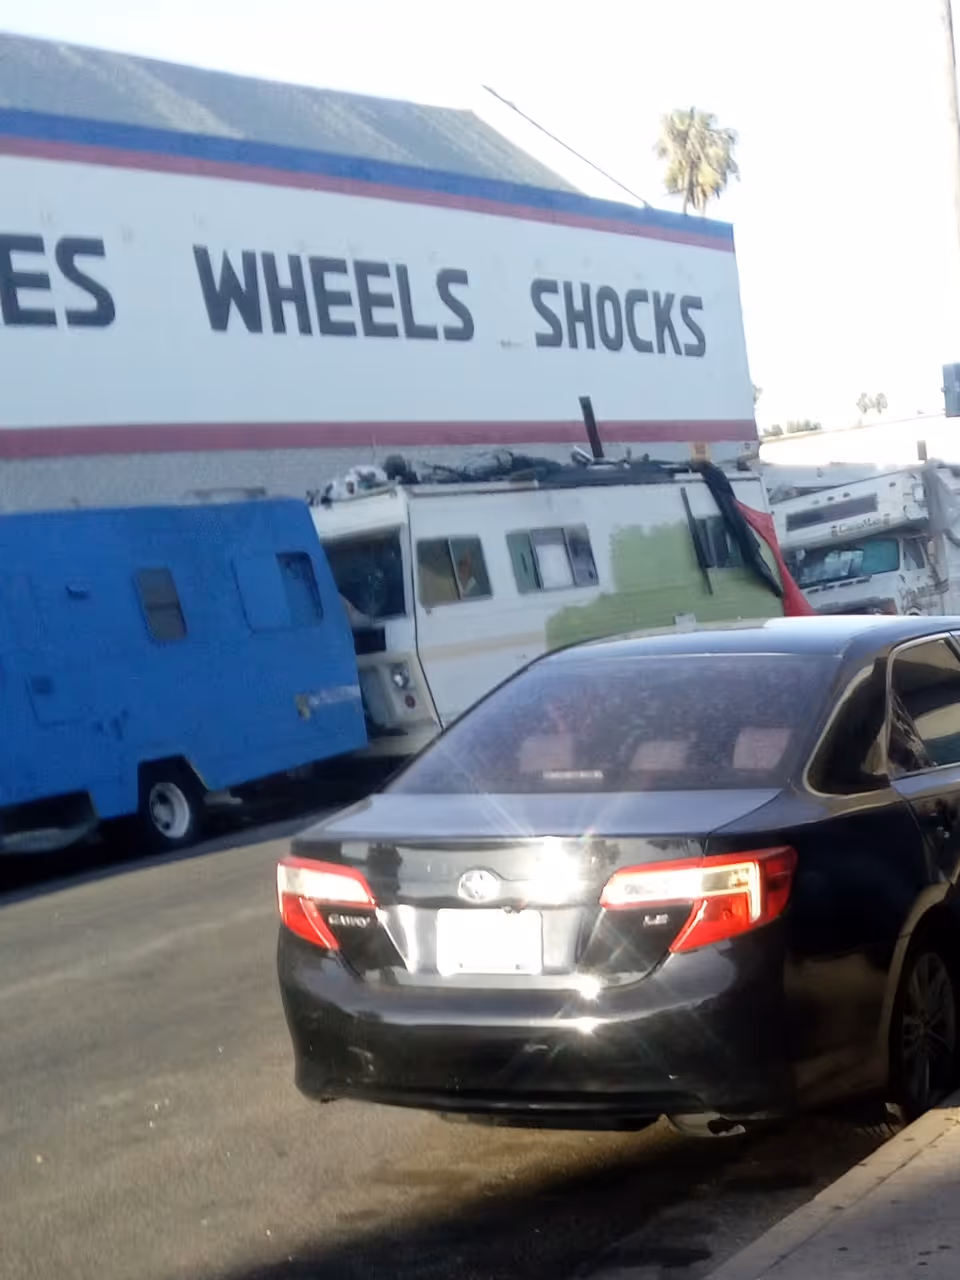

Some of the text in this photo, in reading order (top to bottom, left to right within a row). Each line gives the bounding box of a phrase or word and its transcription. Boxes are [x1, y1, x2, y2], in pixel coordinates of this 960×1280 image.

[0, 233, 706, 358] ES WHEELS SHOCKS
